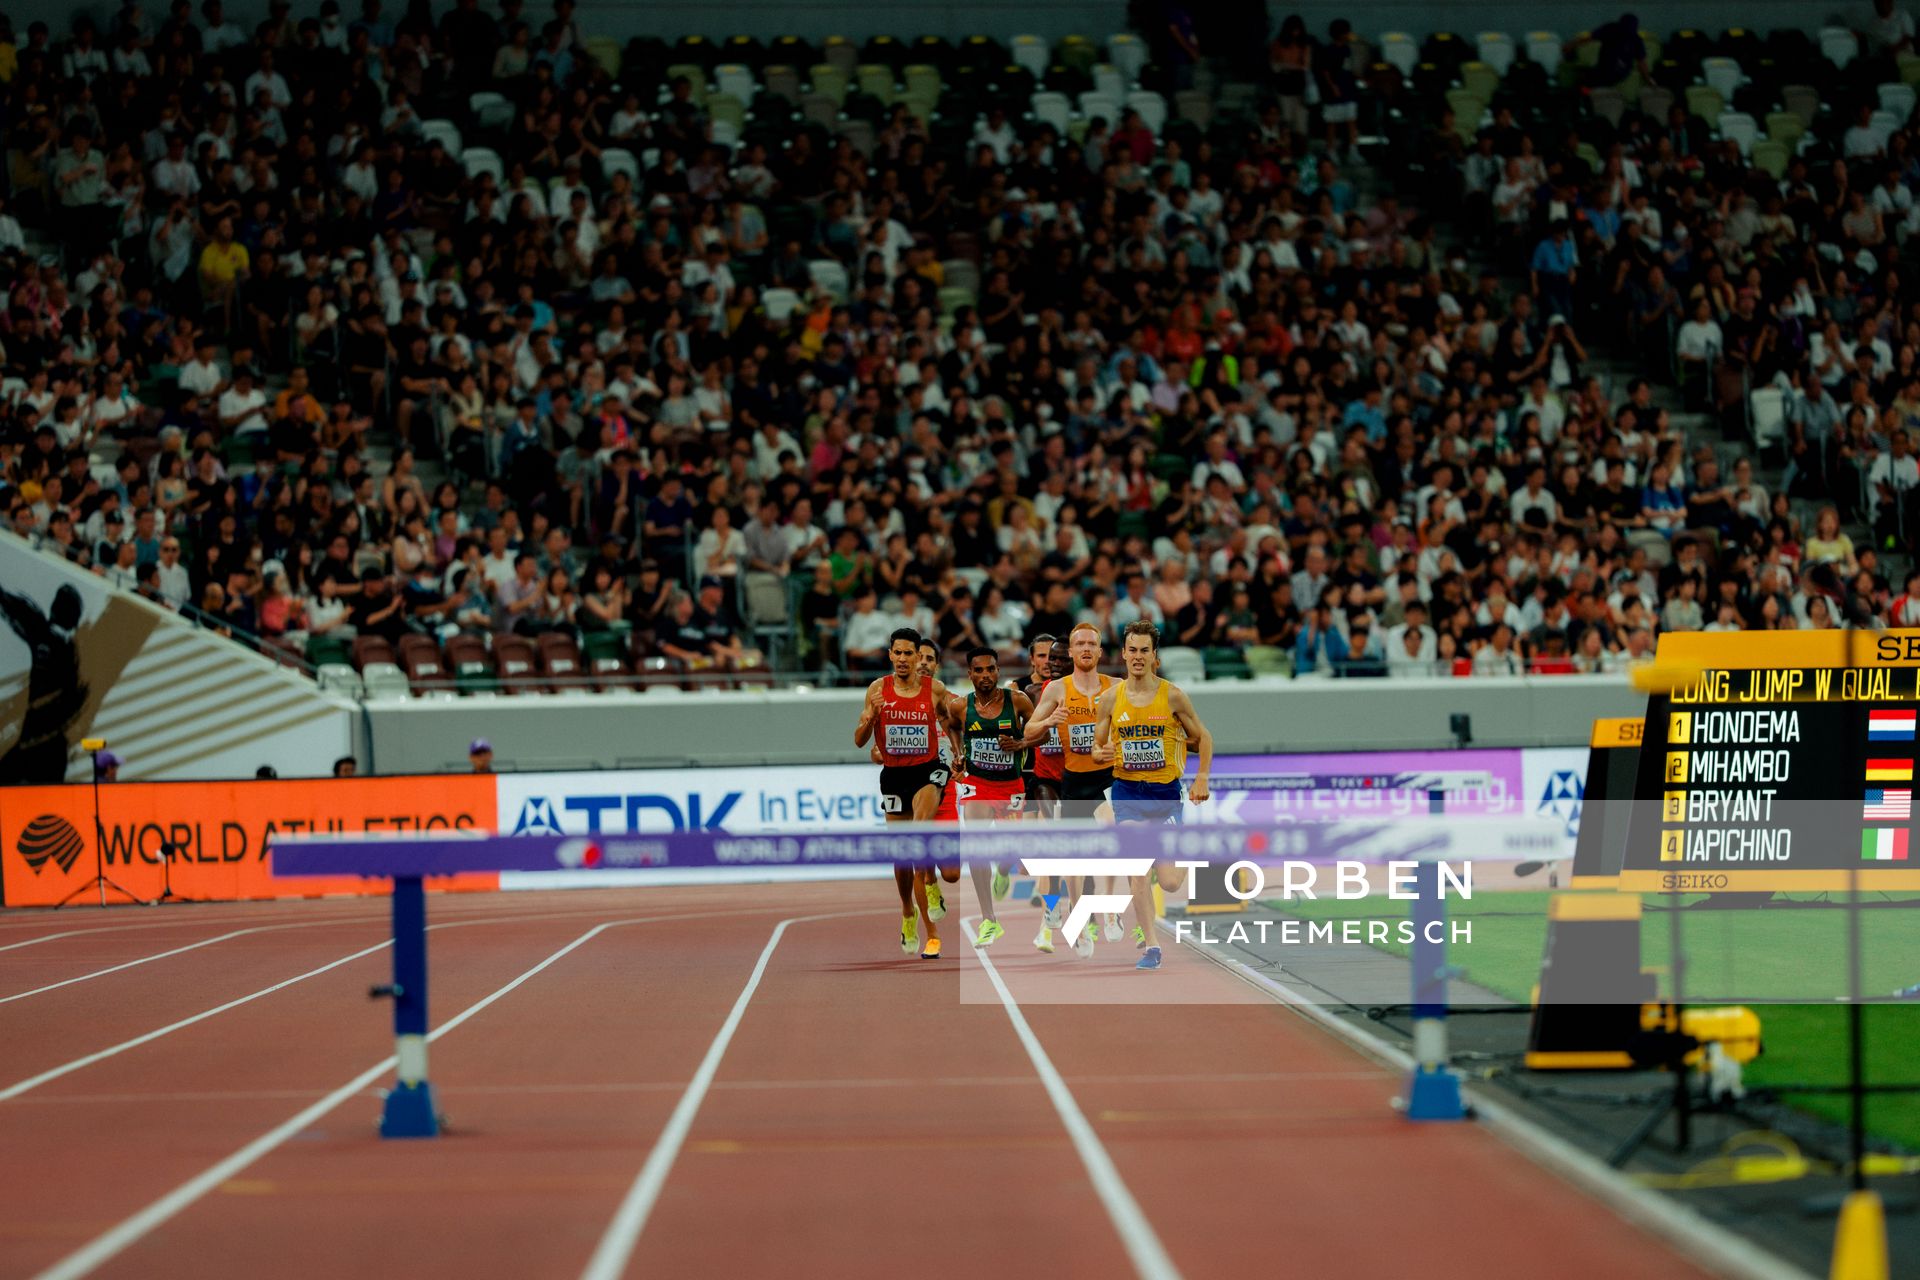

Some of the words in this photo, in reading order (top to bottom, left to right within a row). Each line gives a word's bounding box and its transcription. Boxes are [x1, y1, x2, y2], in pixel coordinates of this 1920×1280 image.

[1740, 669, 1803, 702] JUMP
[1815, 669, 1832, 701] W
[1842, 668, 1904, 700] QUAL.
[885, 710, 928, 720] TUNISIA
[897, 726, 925, 735] TDK
[1118, 725, 1165, 738] SWEDEN
[1675, 719, 1683, 736] 1
[1693, 711, 1800, 743] HONDEMA
[888, 737, 927, 747] JHINAOUI
[1131, 740, 1160, 750] TDK
[973, 750, 1012, 763] FIREWU
[1124, 750, 1164, 762] MAGNUSSON
[1672, 758, 1682, 775] 2
[1690, 750, 1790, 783] MIHAMBO
[565, 792, 743, 835] TDK
[759, 791, 788, 822] In
[887, 797, 896, 810] 7
[1669, 797, 1680, 815] 3
[1688, 790, 1777, 822] BRYANT
[102, 822, 248, 865] WORLD
[713, 837, 799, 862] WORLD
[802, 835, 927, 860] ATHLETICS
[1667, 837, 1677, 855] 4
[1686, 829, 1791, 862] IAPICHINO
[1662, 874, 1728, 890] SEIKO
